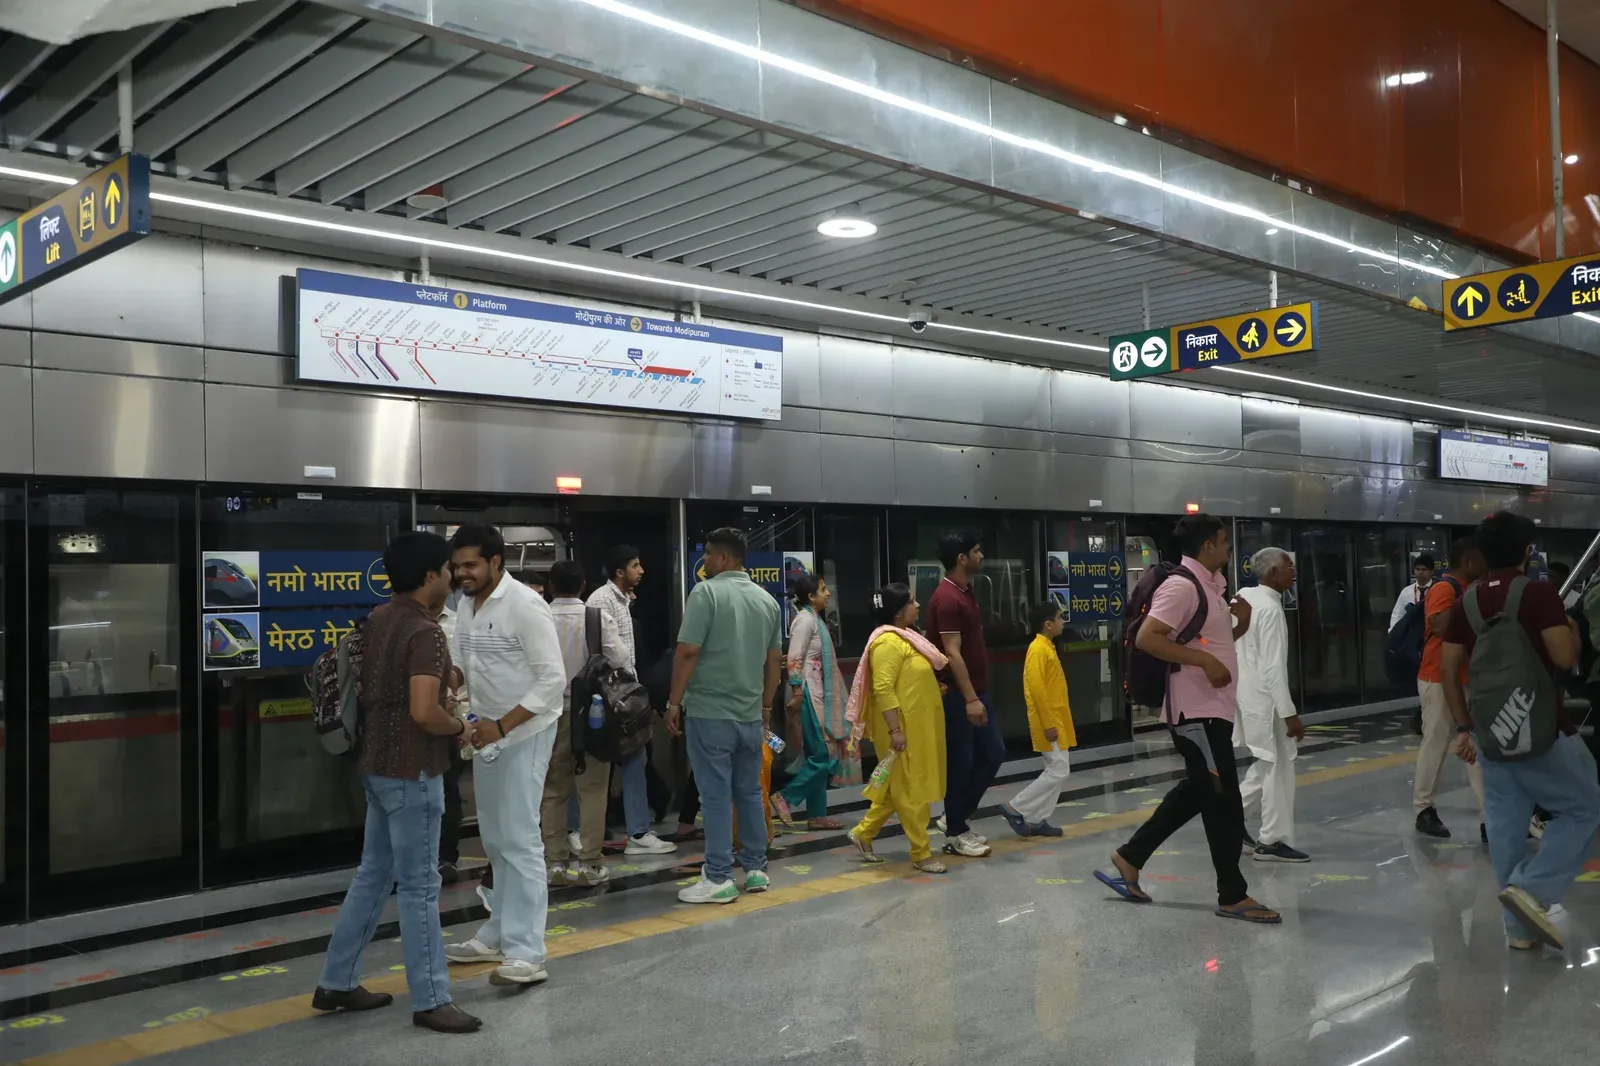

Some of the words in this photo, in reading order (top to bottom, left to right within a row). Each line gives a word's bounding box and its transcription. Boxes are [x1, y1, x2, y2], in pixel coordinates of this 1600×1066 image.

[40, 215, 60, 242] लिफ्ट
[46, 242, 60, 264] Lift
[1571, 265, 1600, 285] निक
[415, 288, 448, 303] प्लेटफॉर्म
[472, 298, 507, 311] Platform
[575, 310, 602, 325] मोदीपुरम
[603, 314, 613, 325] की
[614, 316, 627, 327] ओर
[646, 322, 673, 333] Towards
[674, 326, 710, 338] Modipuram
[1185, 333, 1218, 349] निकास
[1198, 348, 1218, 361] Exit
[266, 565, 307, 592] नमो
[311, 572, 362, 591] भारत
[749, 567, 780, 583] भारत
[1071, 560, 1086, 577] नमो
[1087, 564, 1107, 577] भारत
[1071, 594, 1090, 612] मेरठ
[1091, 594, 1108, 614] मेट्रो
[266, 622, 315, 651] मेरठ
[1490, 687, 1529, 748] NIKE
